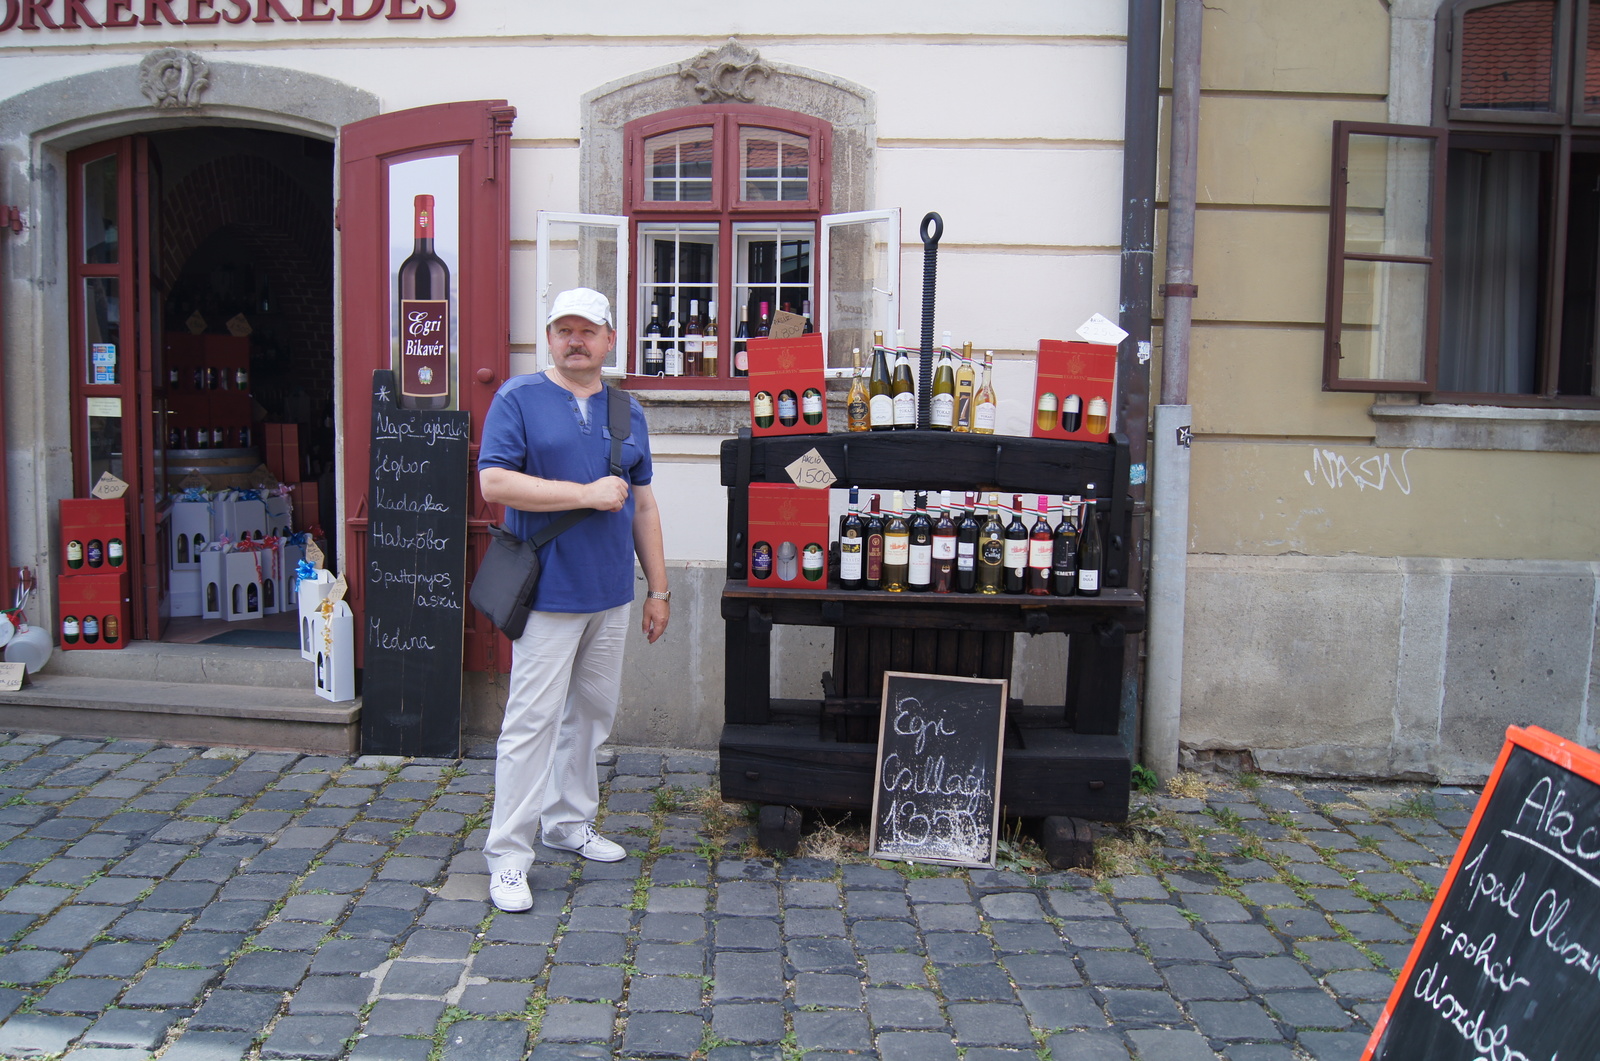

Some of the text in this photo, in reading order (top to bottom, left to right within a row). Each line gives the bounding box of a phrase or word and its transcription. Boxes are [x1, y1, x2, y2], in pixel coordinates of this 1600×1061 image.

[408, 311, 442, 337] Egri
[406, 339, 444, 356] Bikavér
[376, 412, 416, 442] Napi
